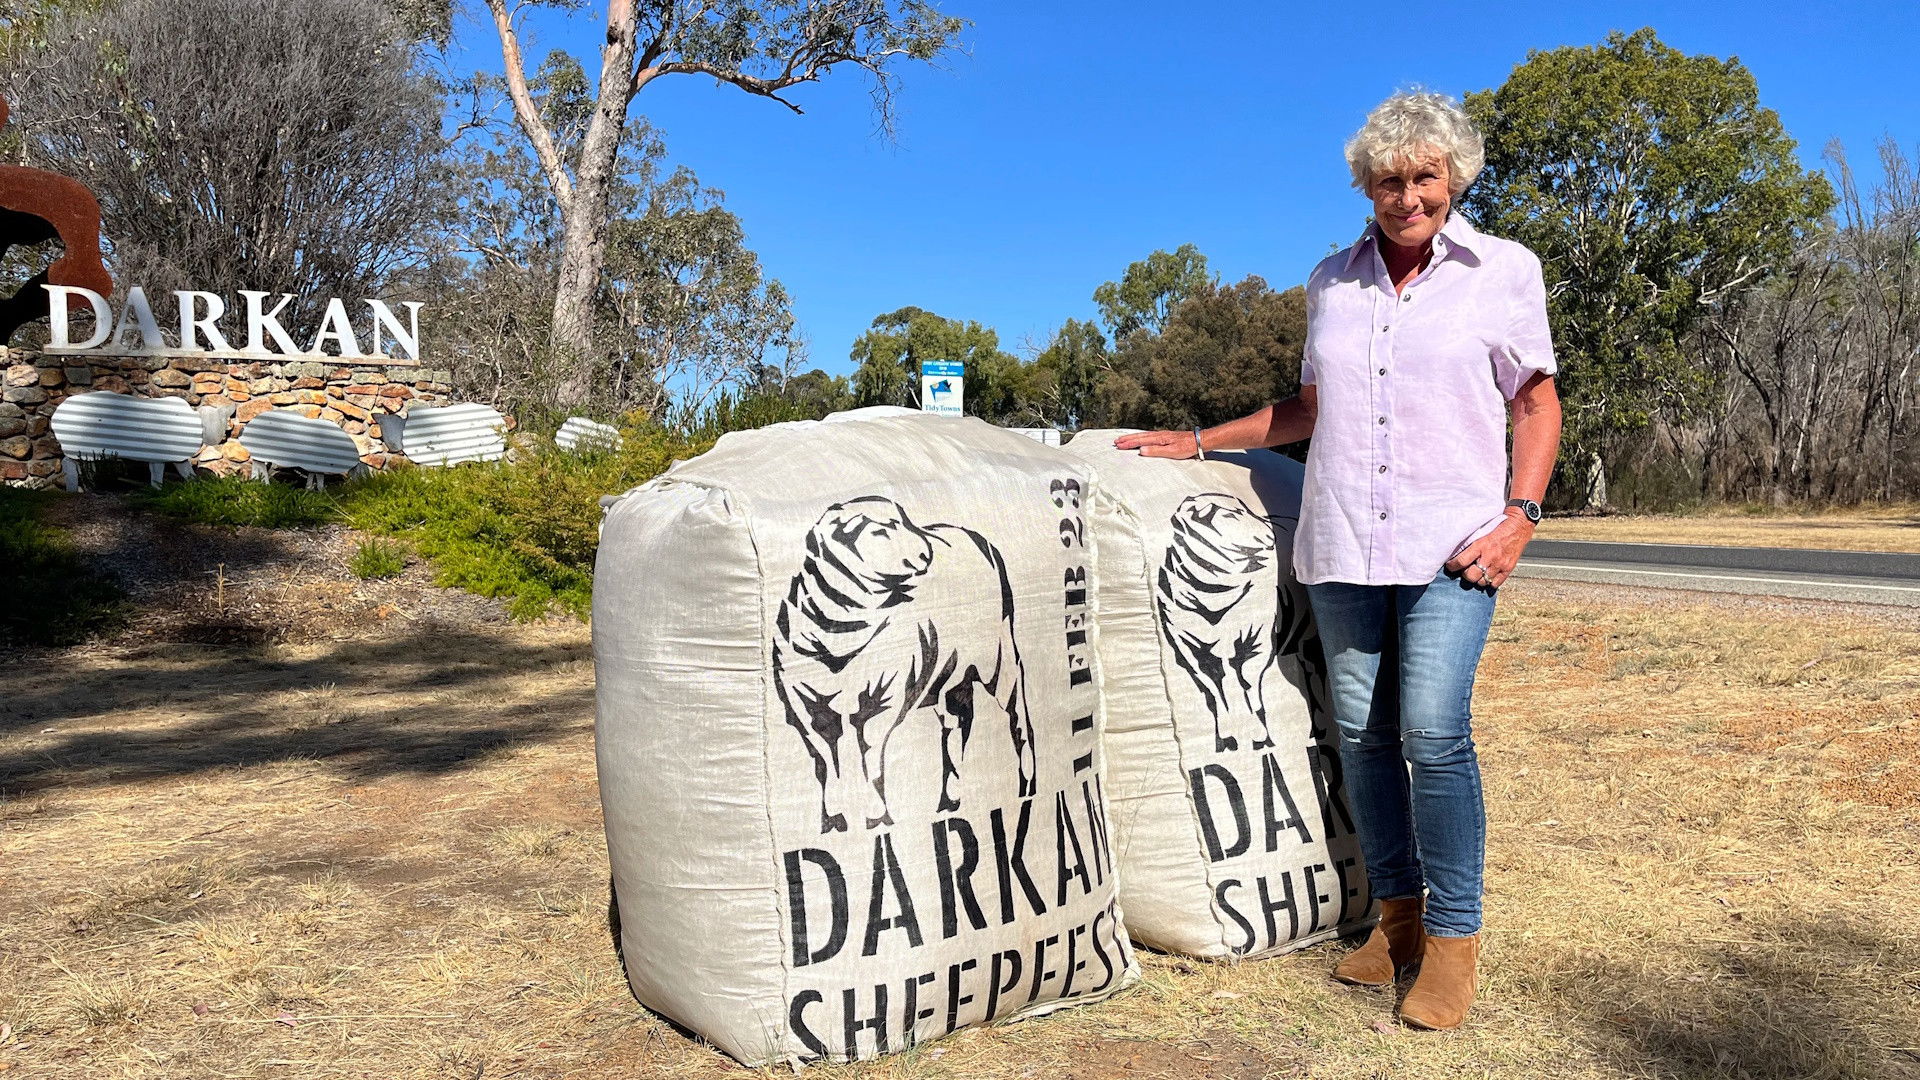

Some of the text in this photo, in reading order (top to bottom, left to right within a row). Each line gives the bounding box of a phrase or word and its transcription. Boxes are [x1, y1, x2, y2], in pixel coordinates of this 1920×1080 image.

[40, 284, 425, 361] DARKAN
[1050, 478, 1084, 548] 23
[1064, 565, 1093, 690] FEB
[1189, 745, 1356, 863] DAR
[783, 773, 1111, 968] DARKAN
